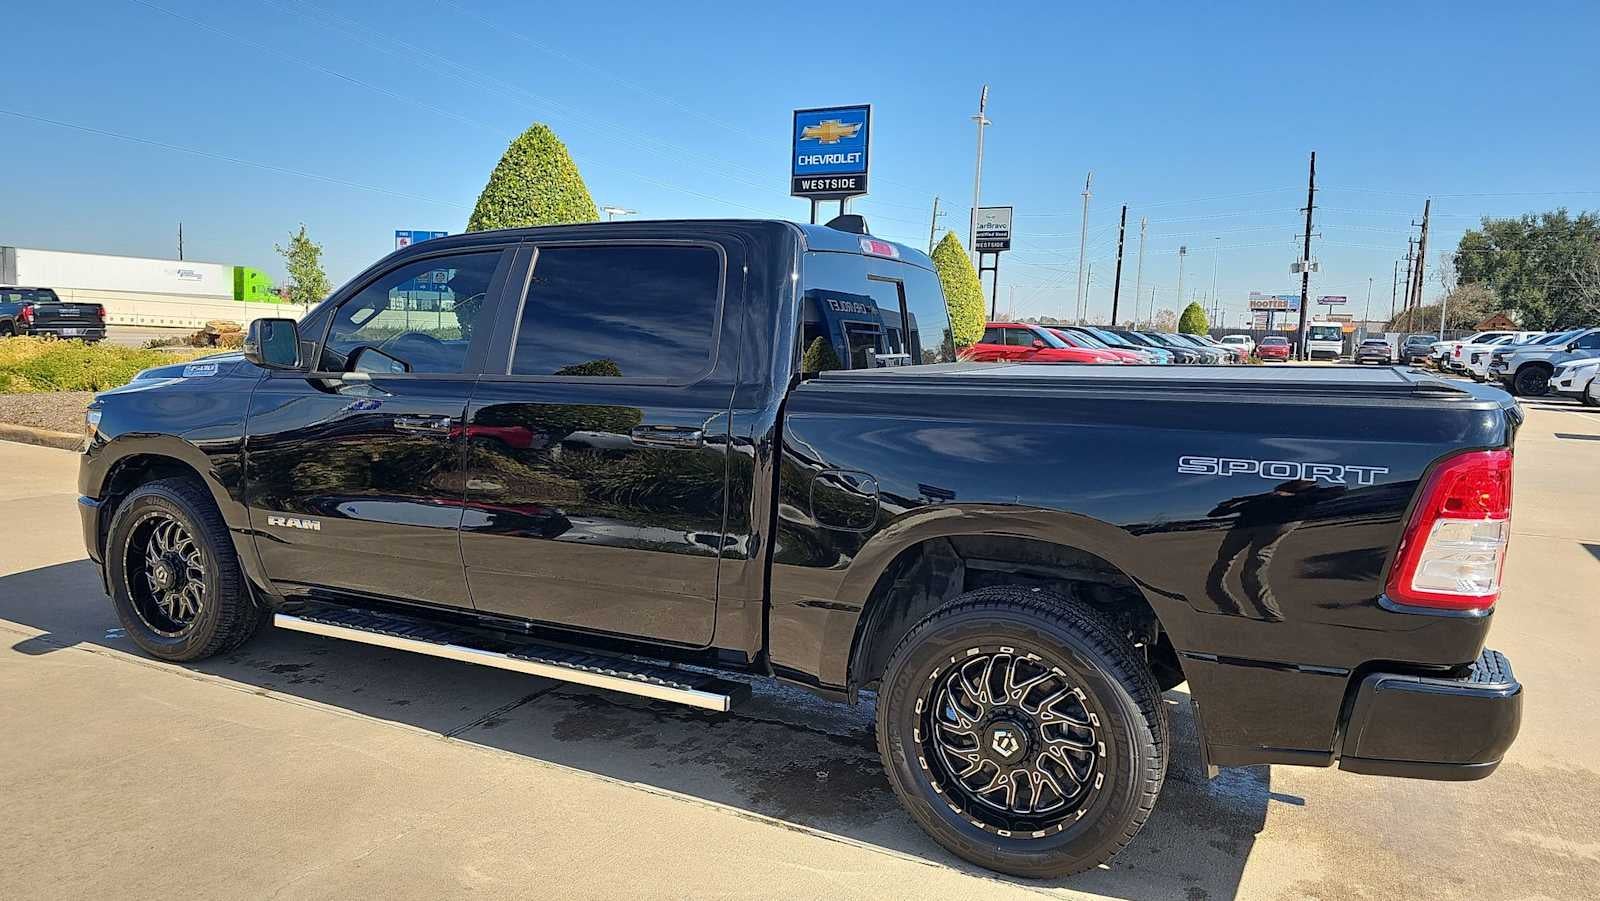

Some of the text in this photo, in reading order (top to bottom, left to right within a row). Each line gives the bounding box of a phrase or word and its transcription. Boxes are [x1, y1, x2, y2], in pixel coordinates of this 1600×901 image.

[798, 152, 862, 166] CHEVROLET
[801, 178, 856, 190] WESTSIDE
[1250, 300, 1288, 308] HOOTERS
[1177, 455, 1389, 486] SPORT
[267, 515, 321, 531] RAM
